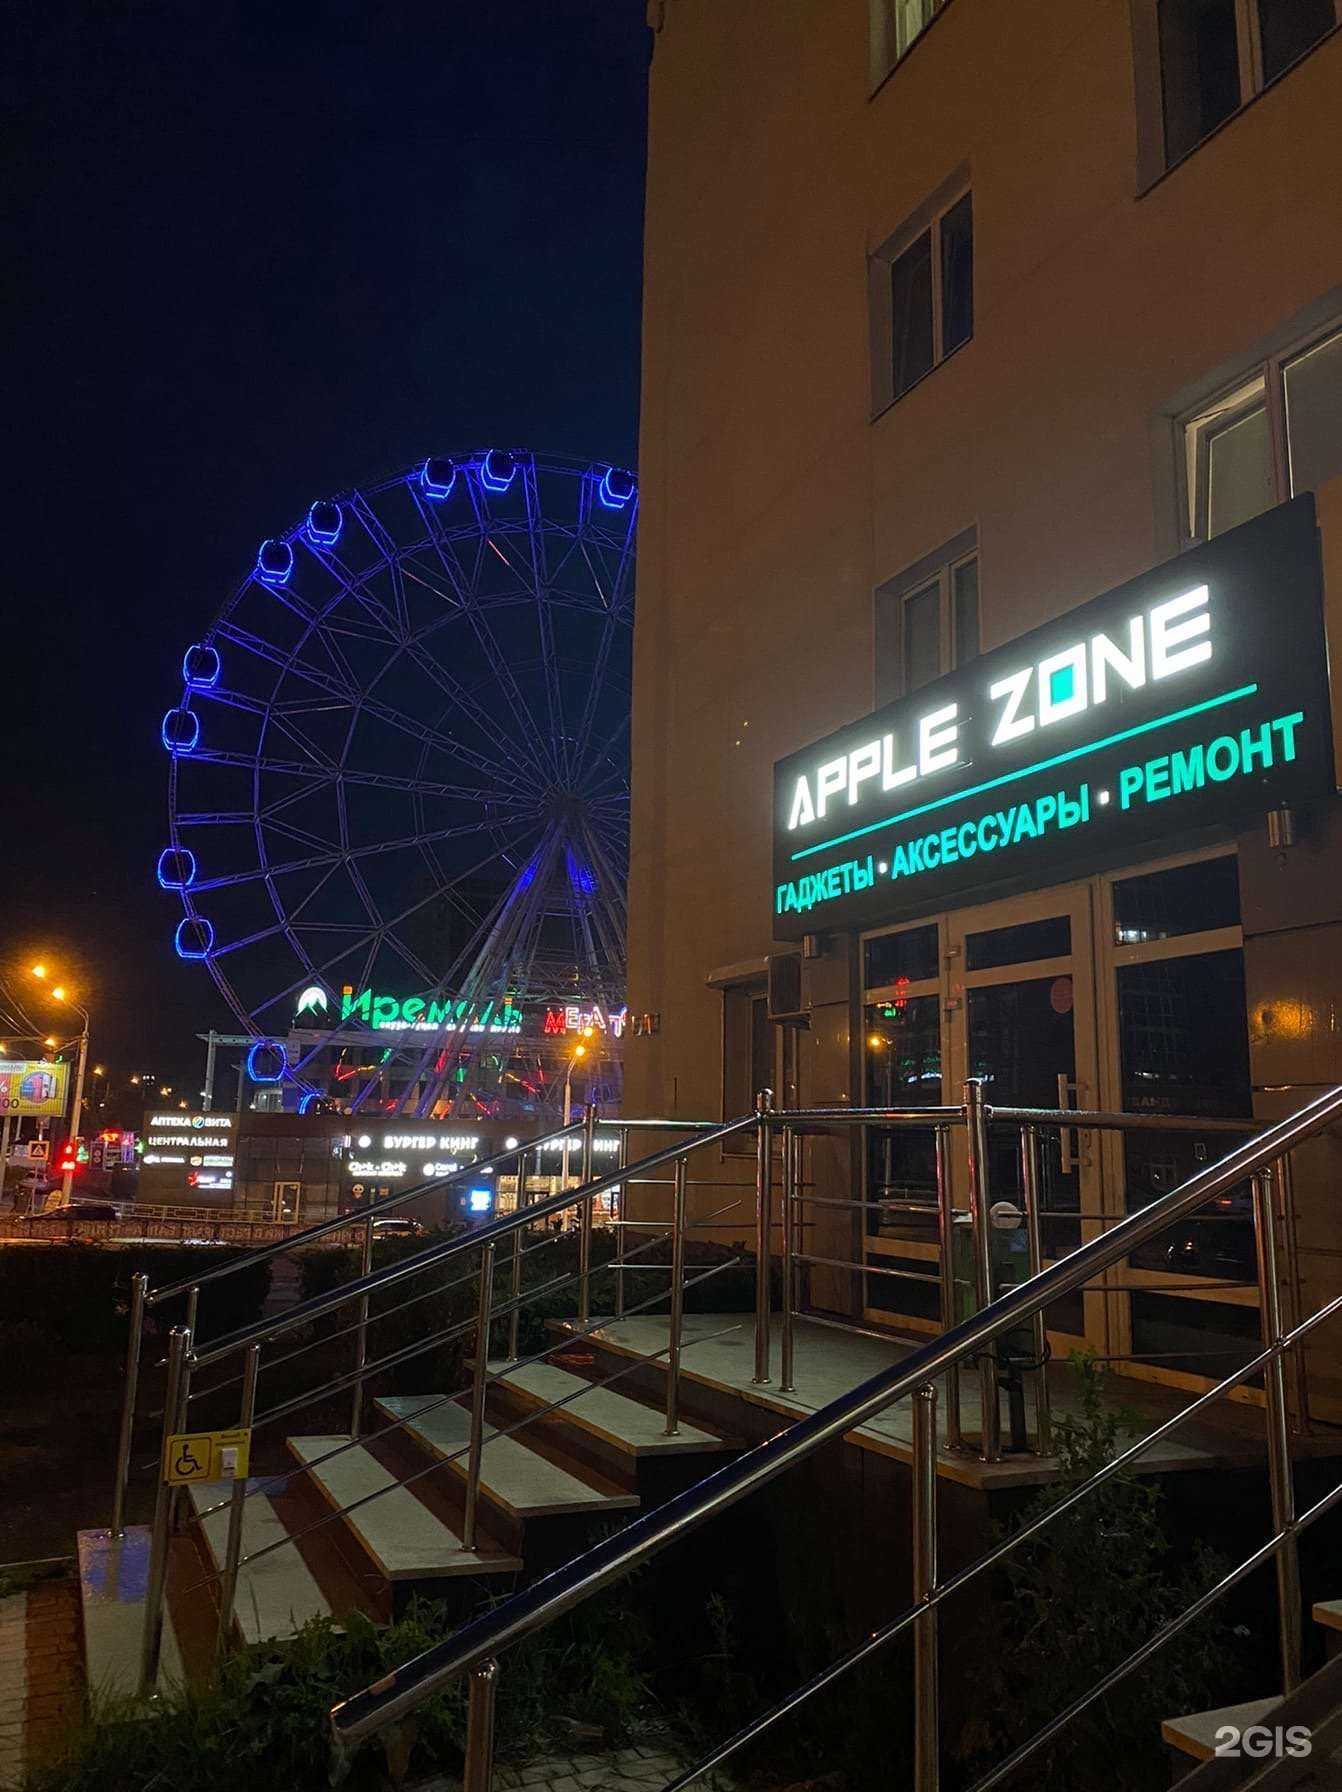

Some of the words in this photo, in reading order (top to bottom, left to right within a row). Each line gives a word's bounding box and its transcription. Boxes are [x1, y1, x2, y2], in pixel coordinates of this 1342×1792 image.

[788, 703, 958, 830] APPLE
[990, 585, 1213, 746] ZONE
[776, 855, 874, 914] ГАДЖЕТЫ
[891, 784, 1089, 880] АКСЕССУАРЫ
[1120, 711, 1303, 810] РЕМОНТ
[150, 1116, 191, 1127] АПТЕКА
[204, 1117, 232, 1128] ВИТА
[148, 1136, 228, 1147] ЦЕНТРАЛЬНАЯ
[383, 1135, 436, 1148] БУРГЕР
[440, 1136, 479, 1149] КИНГ
